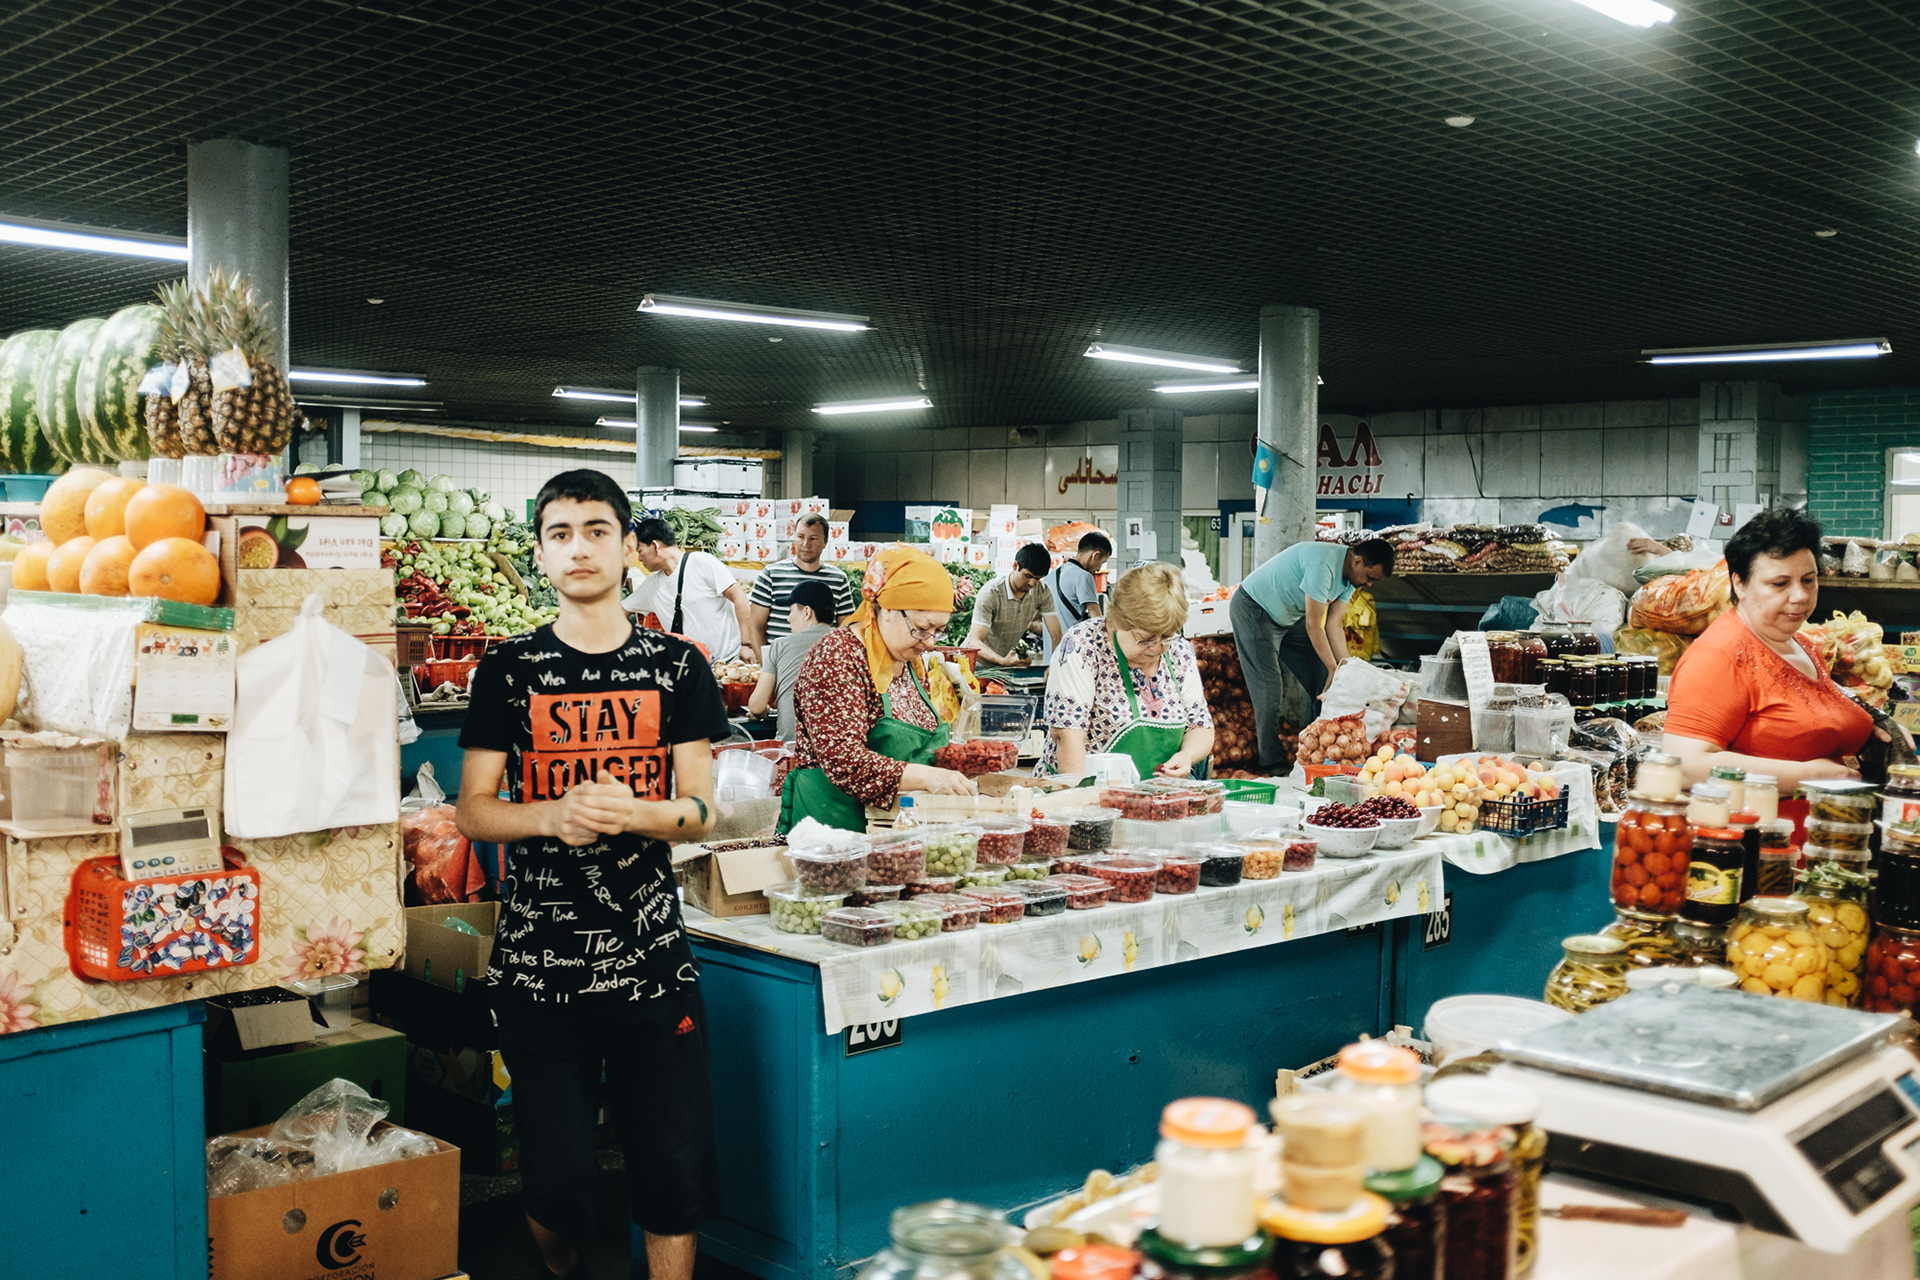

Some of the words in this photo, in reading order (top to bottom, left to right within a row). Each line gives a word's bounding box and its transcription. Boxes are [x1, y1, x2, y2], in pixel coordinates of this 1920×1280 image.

[550, 698, 641, 743] STAY
[530, 755, 662, 801] LONGER
[1425, 898, 1451, 944] 285
[573, 929, 625, 956] The
[512, 972, 546, 990] Pink
[577, 972, 640, 995] London
[306, 1262, 375, 1280] ORPORACION
